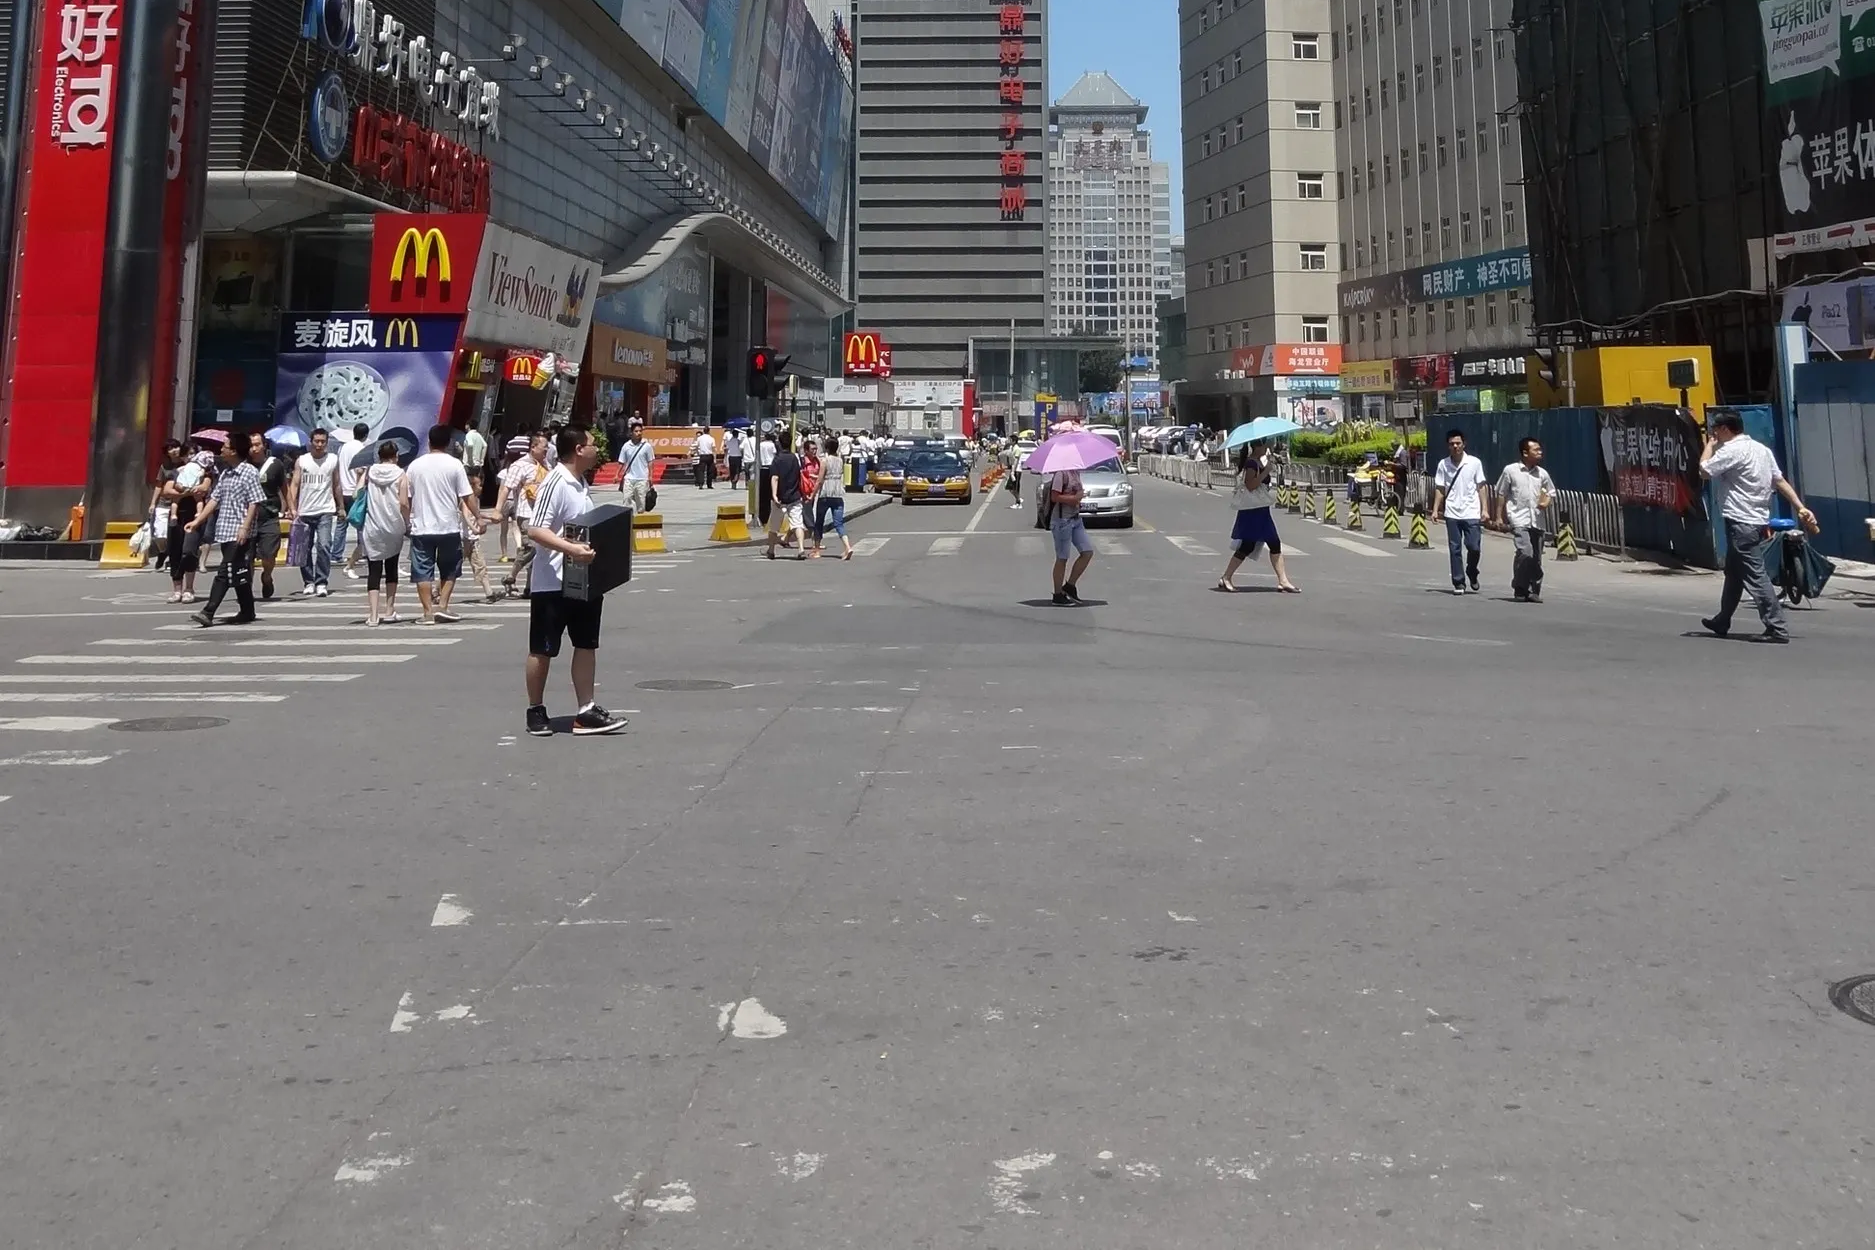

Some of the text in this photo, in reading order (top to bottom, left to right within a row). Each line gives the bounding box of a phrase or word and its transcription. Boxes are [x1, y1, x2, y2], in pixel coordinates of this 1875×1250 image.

[50, 66, 69, 138] Electronics
[999, 6, 1025, 214] 鼎好电子商城
[486, 251, 559, 322] ViewSonic
[294, 318, 378, 349] 麦旋风
[614, 338, 643, 365] lenovo
[1292, 347, 1325, 356] 中国联通
[1045, 403, 1053, 413] P
[1614, 426, 1689, 471] 苹果体验中心
